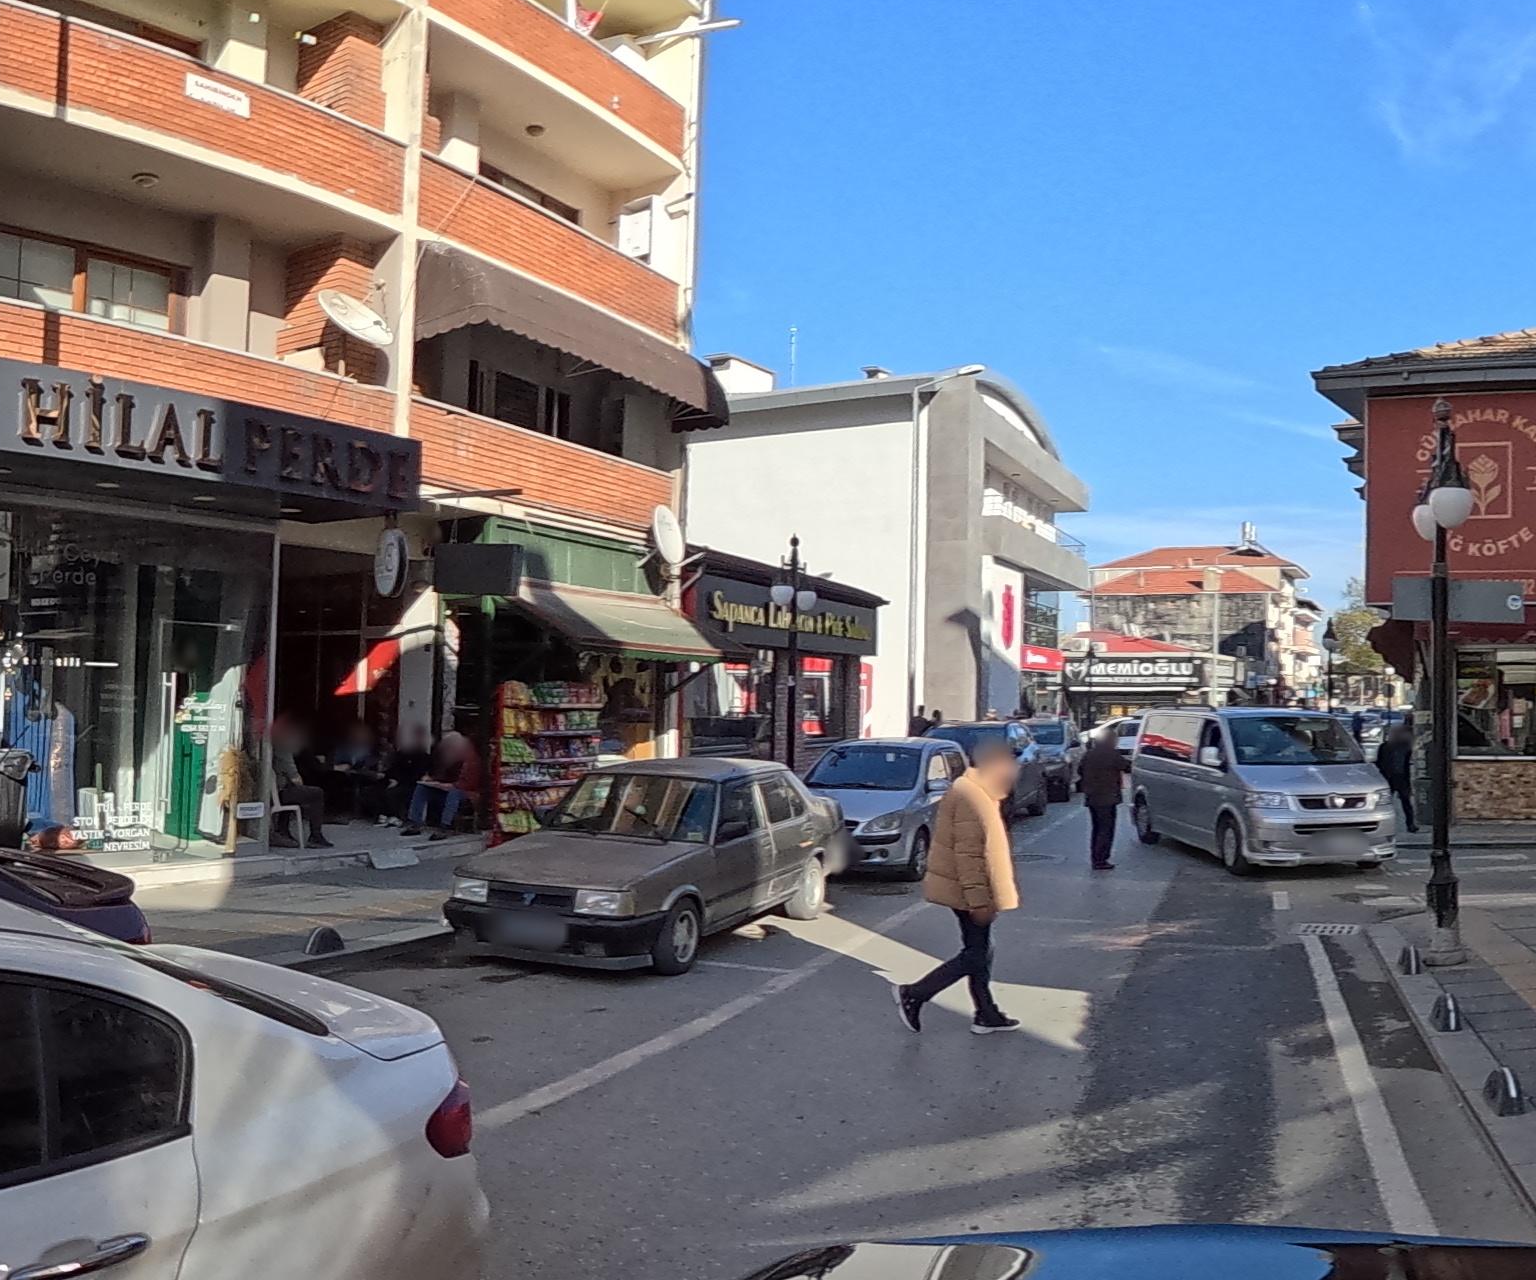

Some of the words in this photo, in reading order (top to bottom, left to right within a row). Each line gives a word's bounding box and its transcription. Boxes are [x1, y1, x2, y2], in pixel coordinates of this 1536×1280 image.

[18, 375, 224, 474] HİLAL
[242, 417, 411, 499] PERDE
[1467, 527, 1535, 557] KÖFTE
[1089, 659, 1194, 676] MEMİOĞLU
